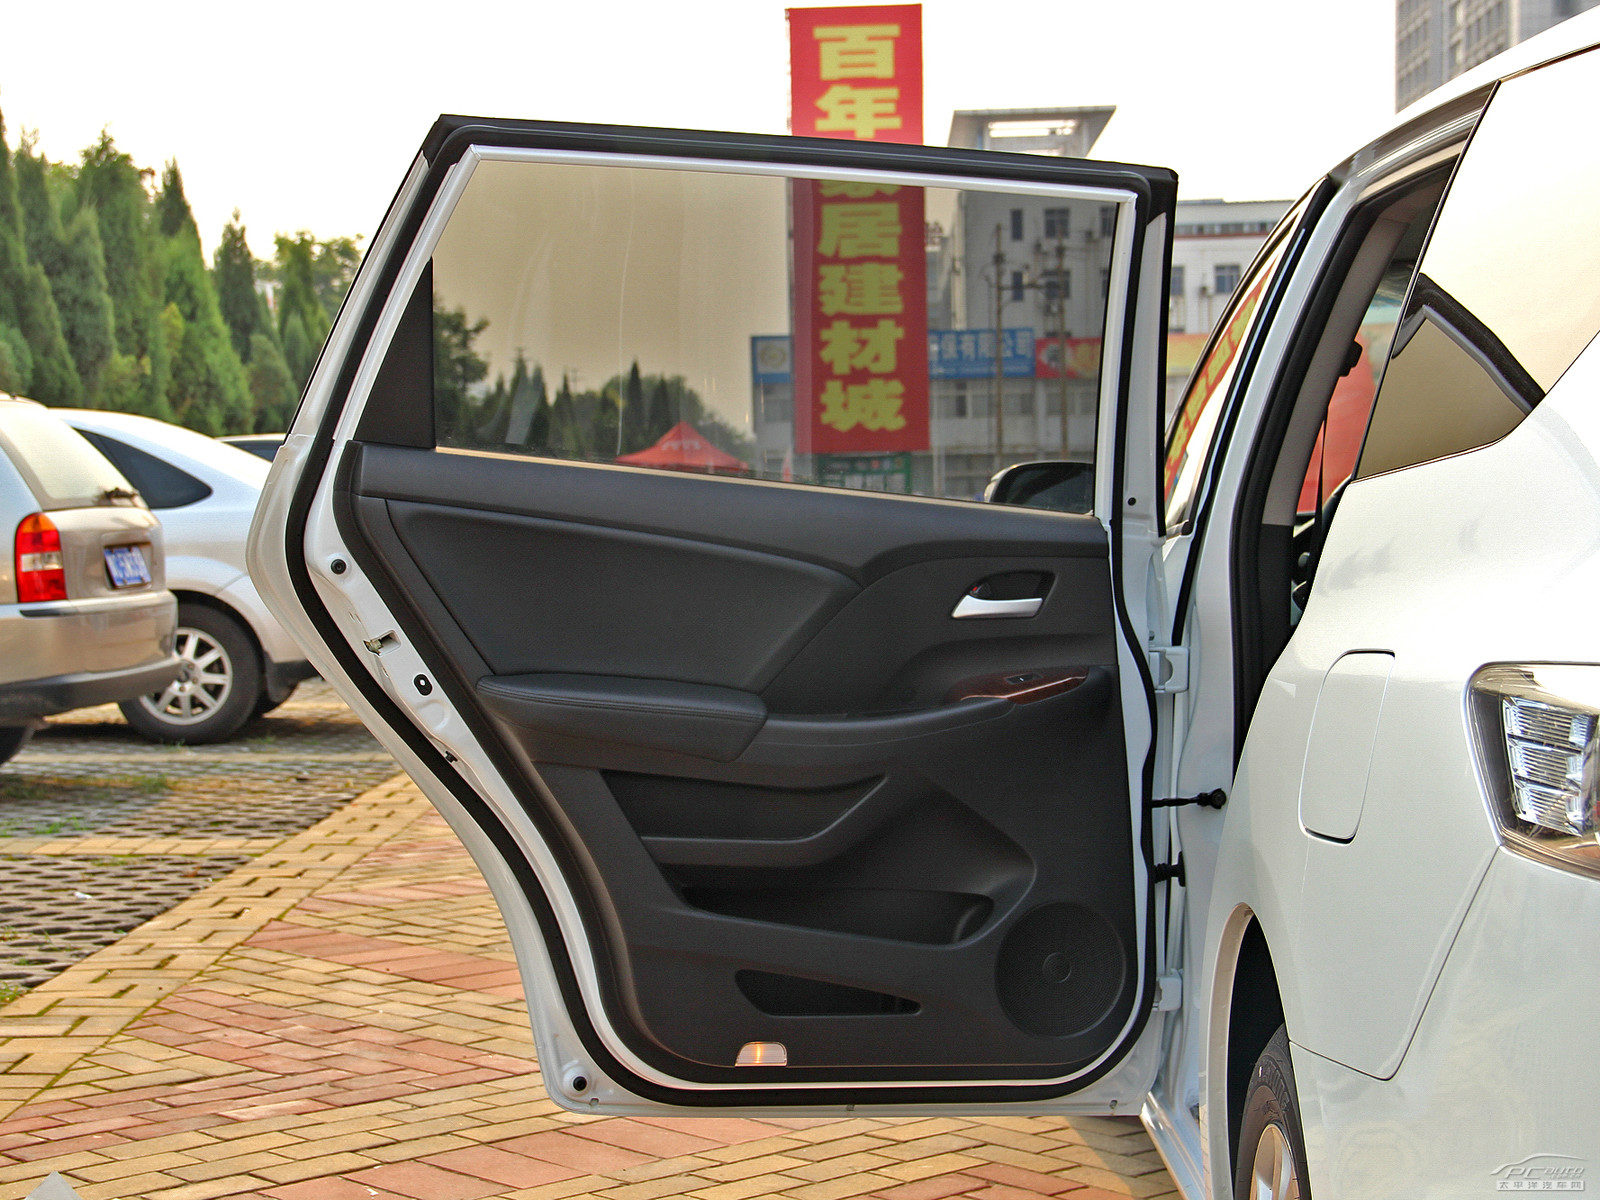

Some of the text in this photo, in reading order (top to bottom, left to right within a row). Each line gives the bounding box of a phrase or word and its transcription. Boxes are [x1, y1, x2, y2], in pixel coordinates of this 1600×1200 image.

[812, 23, 906, 433] 百年居建材城
